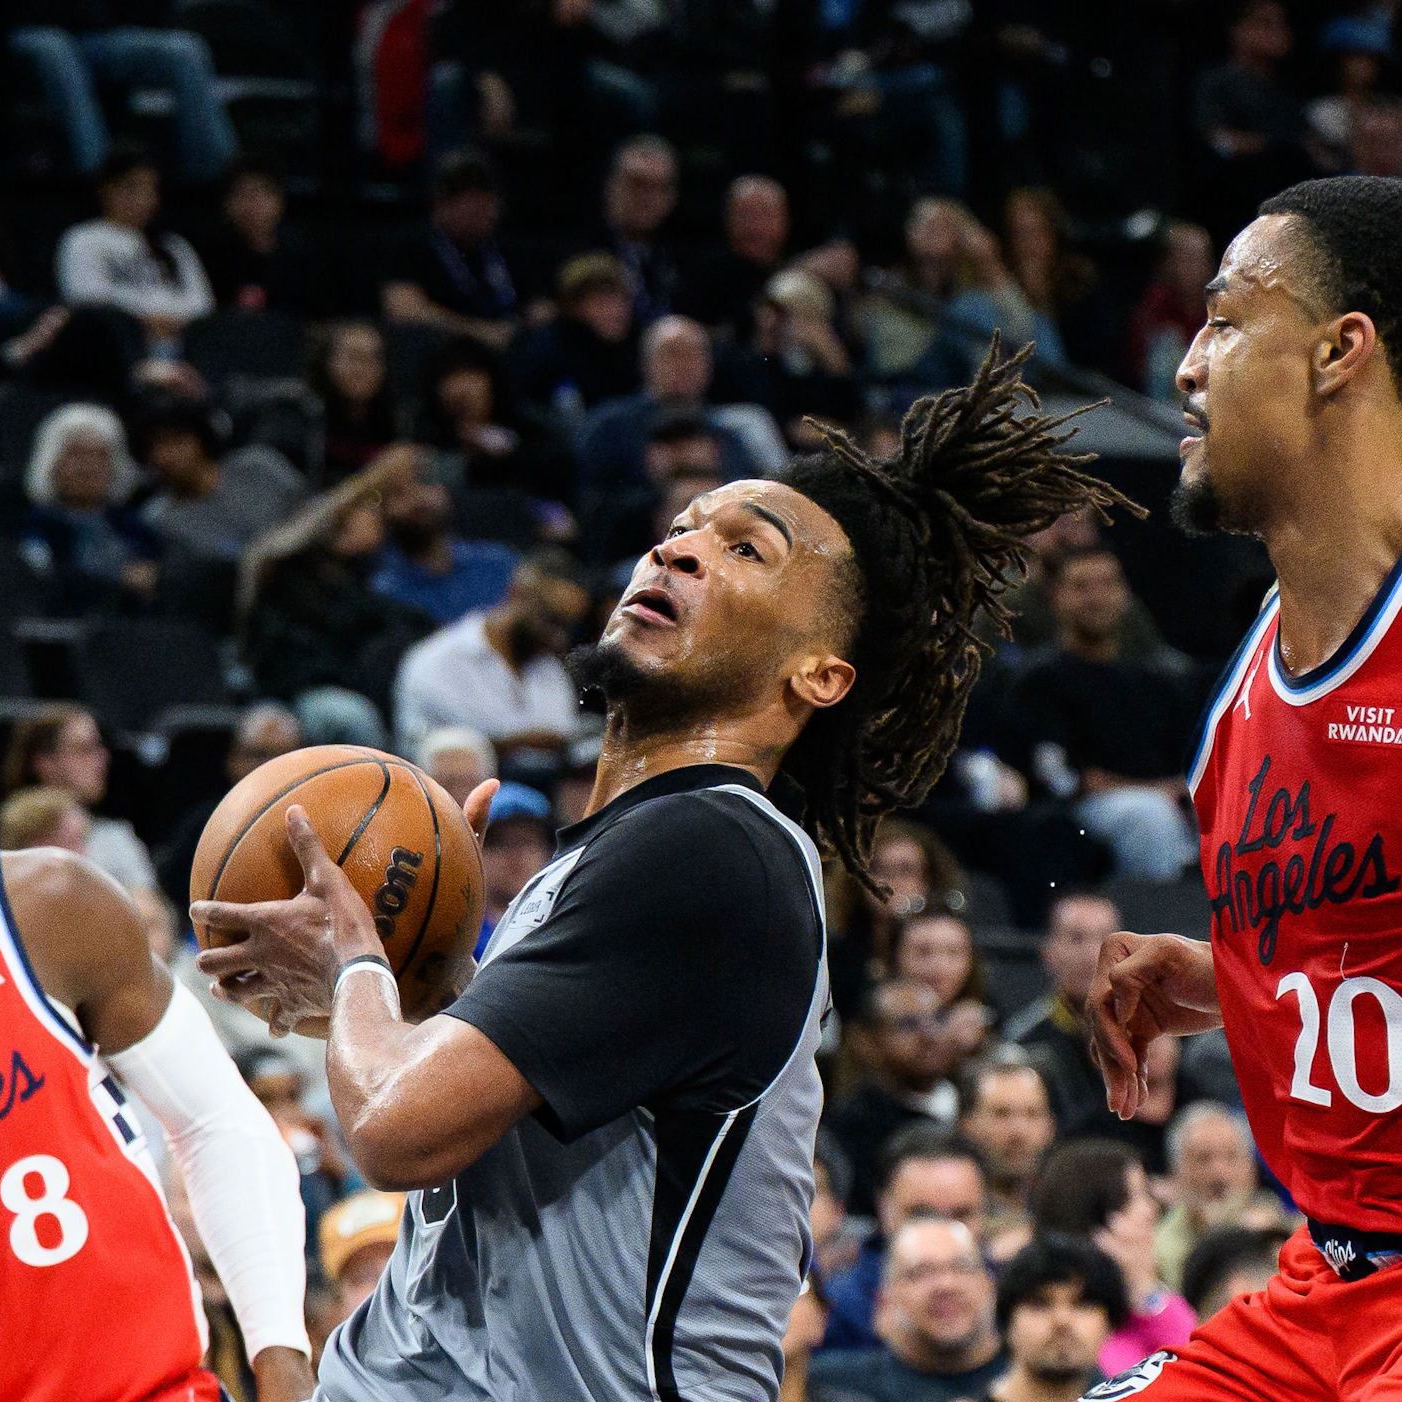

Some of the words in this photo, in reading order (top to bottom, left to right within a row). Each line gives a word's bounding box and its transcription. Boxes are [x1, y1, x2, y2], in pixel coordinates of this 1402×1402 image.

[1346, 705, 1395, 725] VISIT
[1236, 753, 1316, 858] Los
[1211, 815, 1400, 967] Angeles
[0, 1154, 89, 1267] 8
